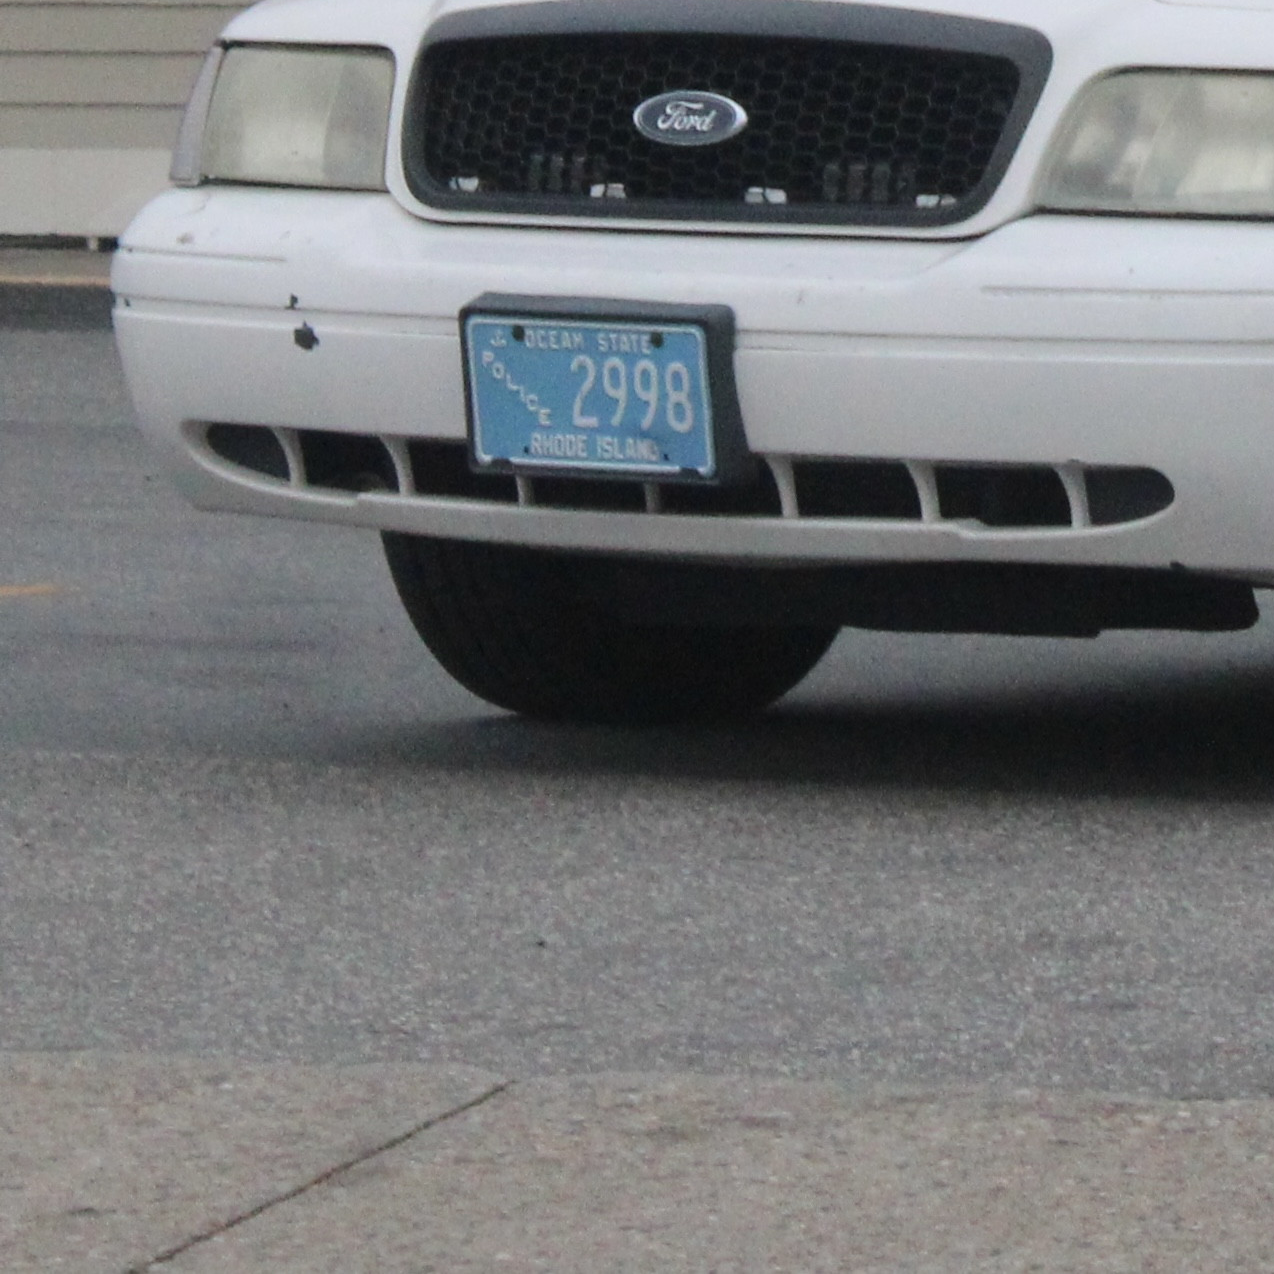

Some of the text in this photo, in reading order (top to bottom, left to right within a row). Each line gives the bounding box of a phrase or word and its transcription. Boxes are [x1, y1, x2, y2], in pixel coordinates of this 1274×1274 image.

[657, 101, 717, 132] Ford
[524, 328, 651, 355] OCEAN STATE
[480, 351, 552, 426] POLICE
[570, 354, 694, 433] 2998
[530, 432, 660, 462] RHODE ISLAND
